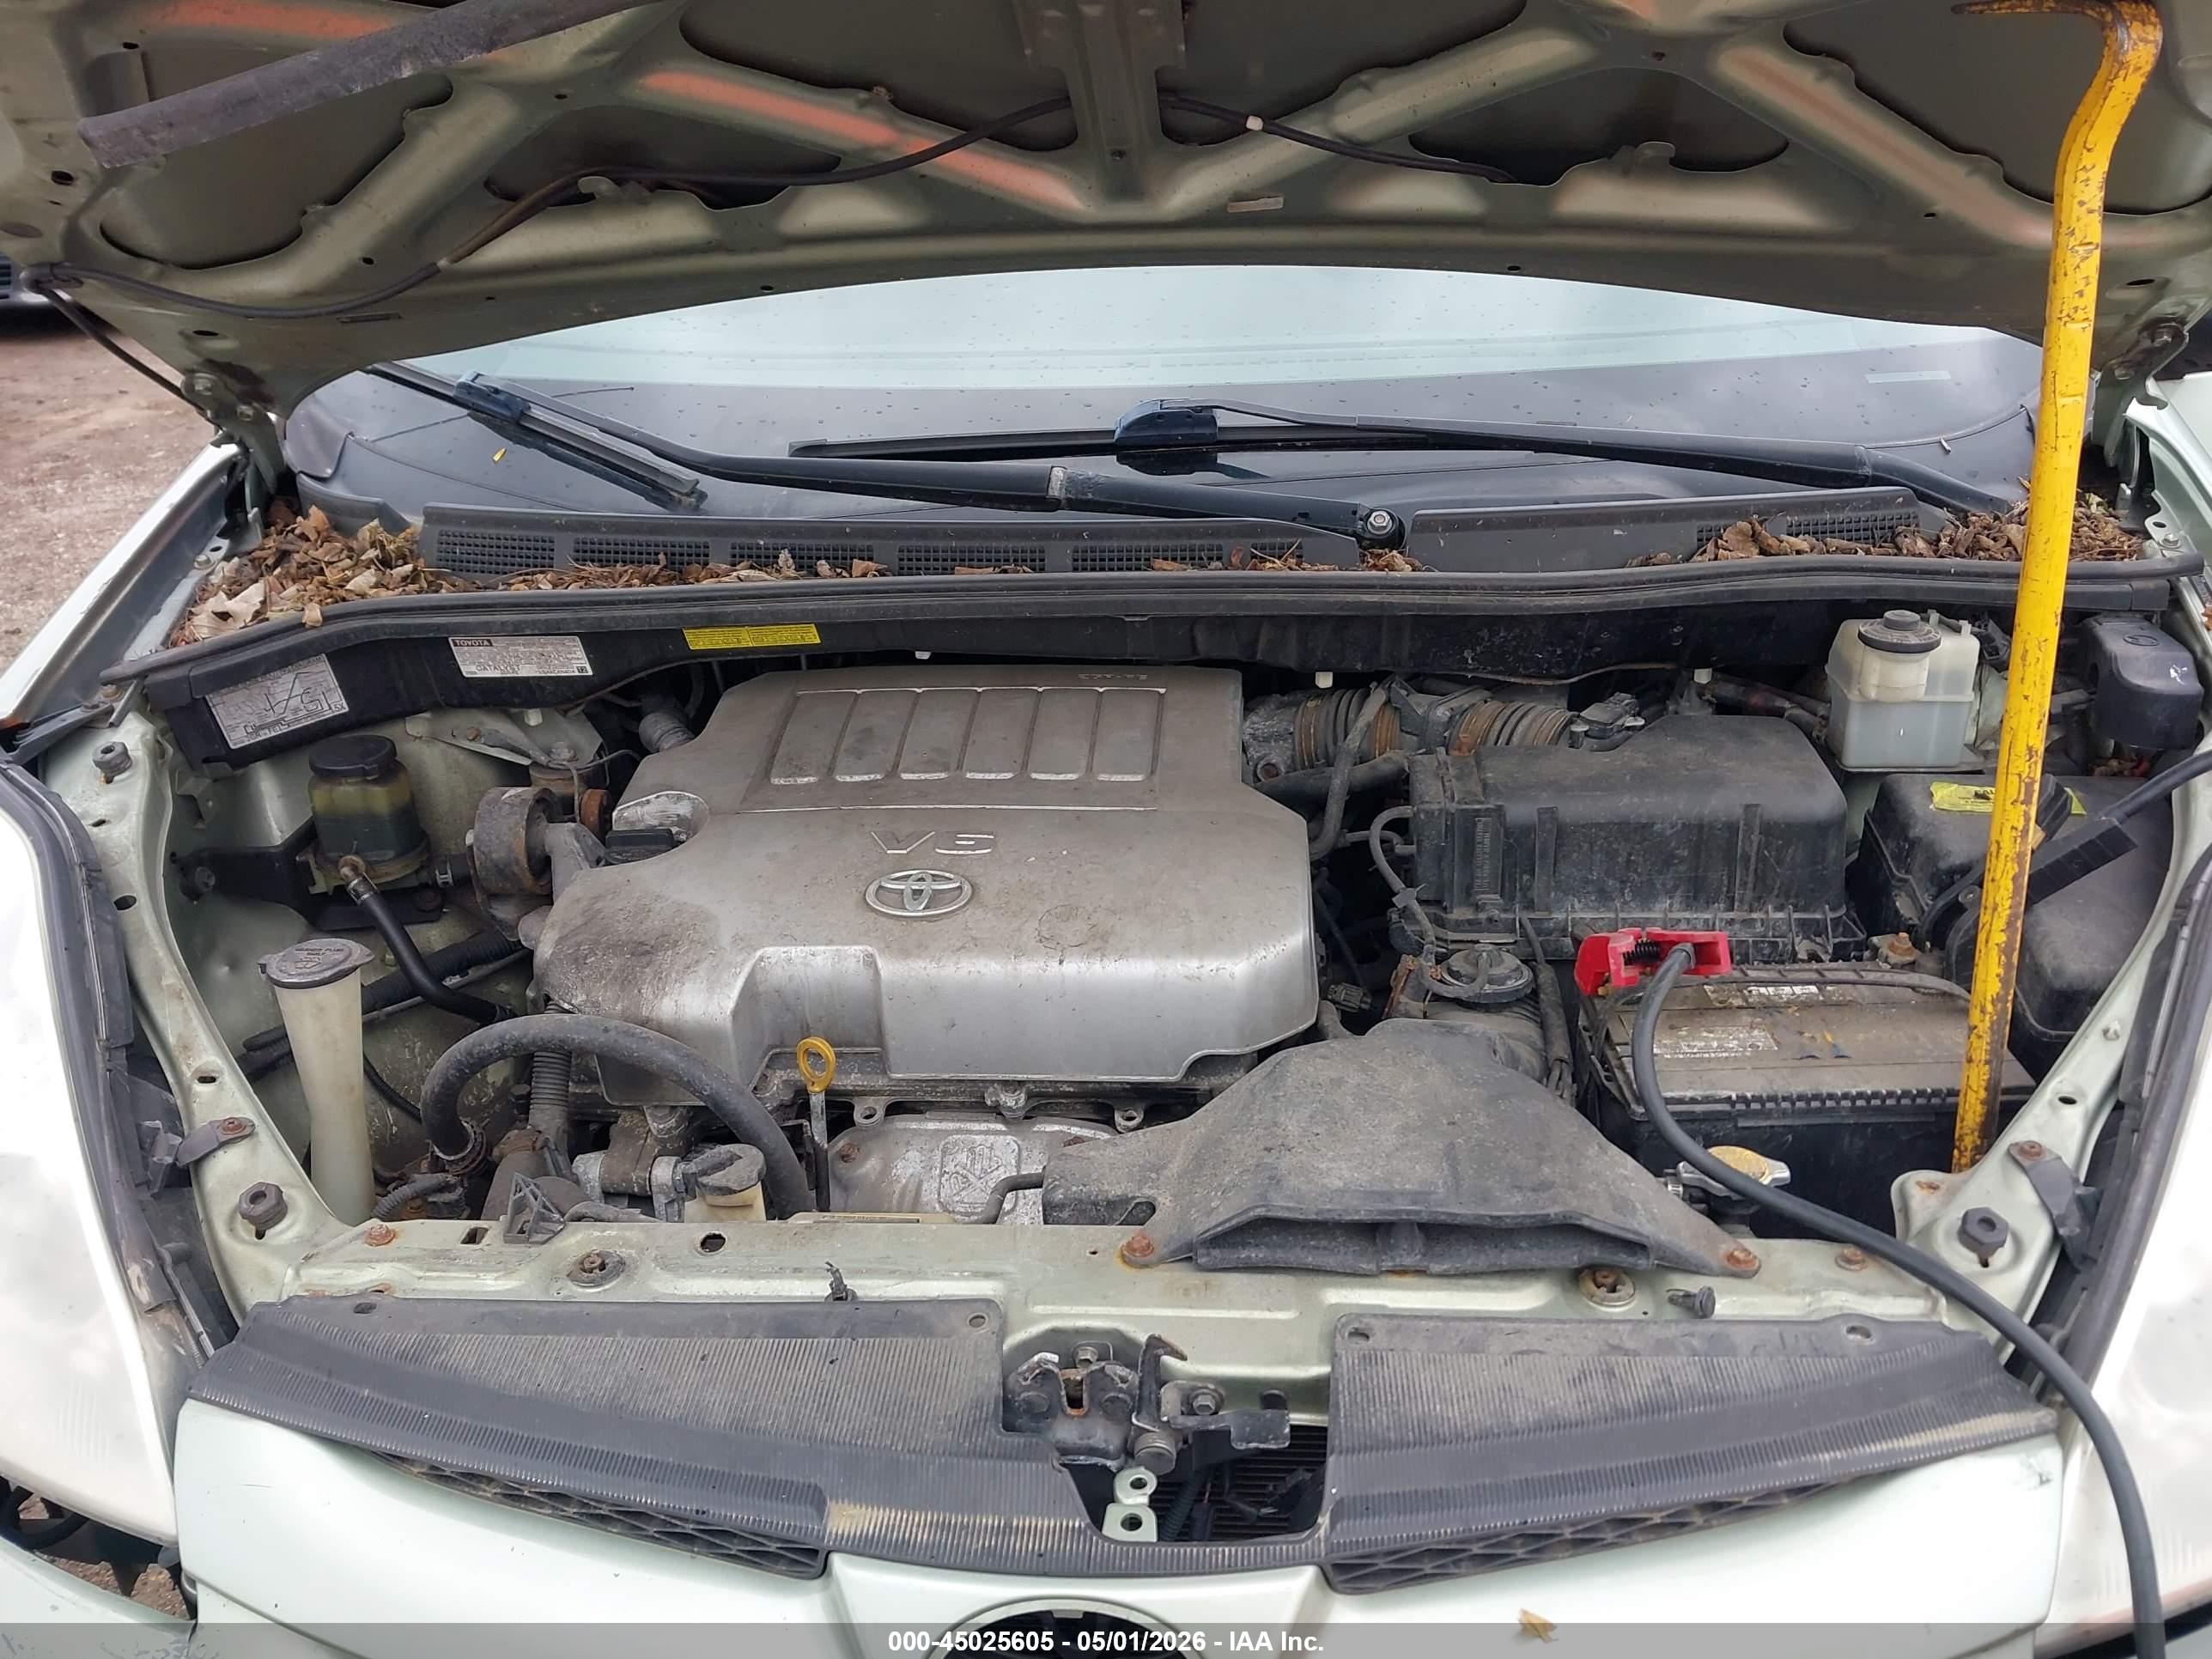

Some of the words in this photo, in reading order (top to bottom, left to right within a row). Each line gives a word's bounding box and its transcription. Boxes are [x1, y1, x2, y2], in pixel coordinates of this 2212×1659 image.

[475, 664, 521, 672] CATALYST
[333, 702, 347, 713] 5X
[869, 830, 996, 856] V6
